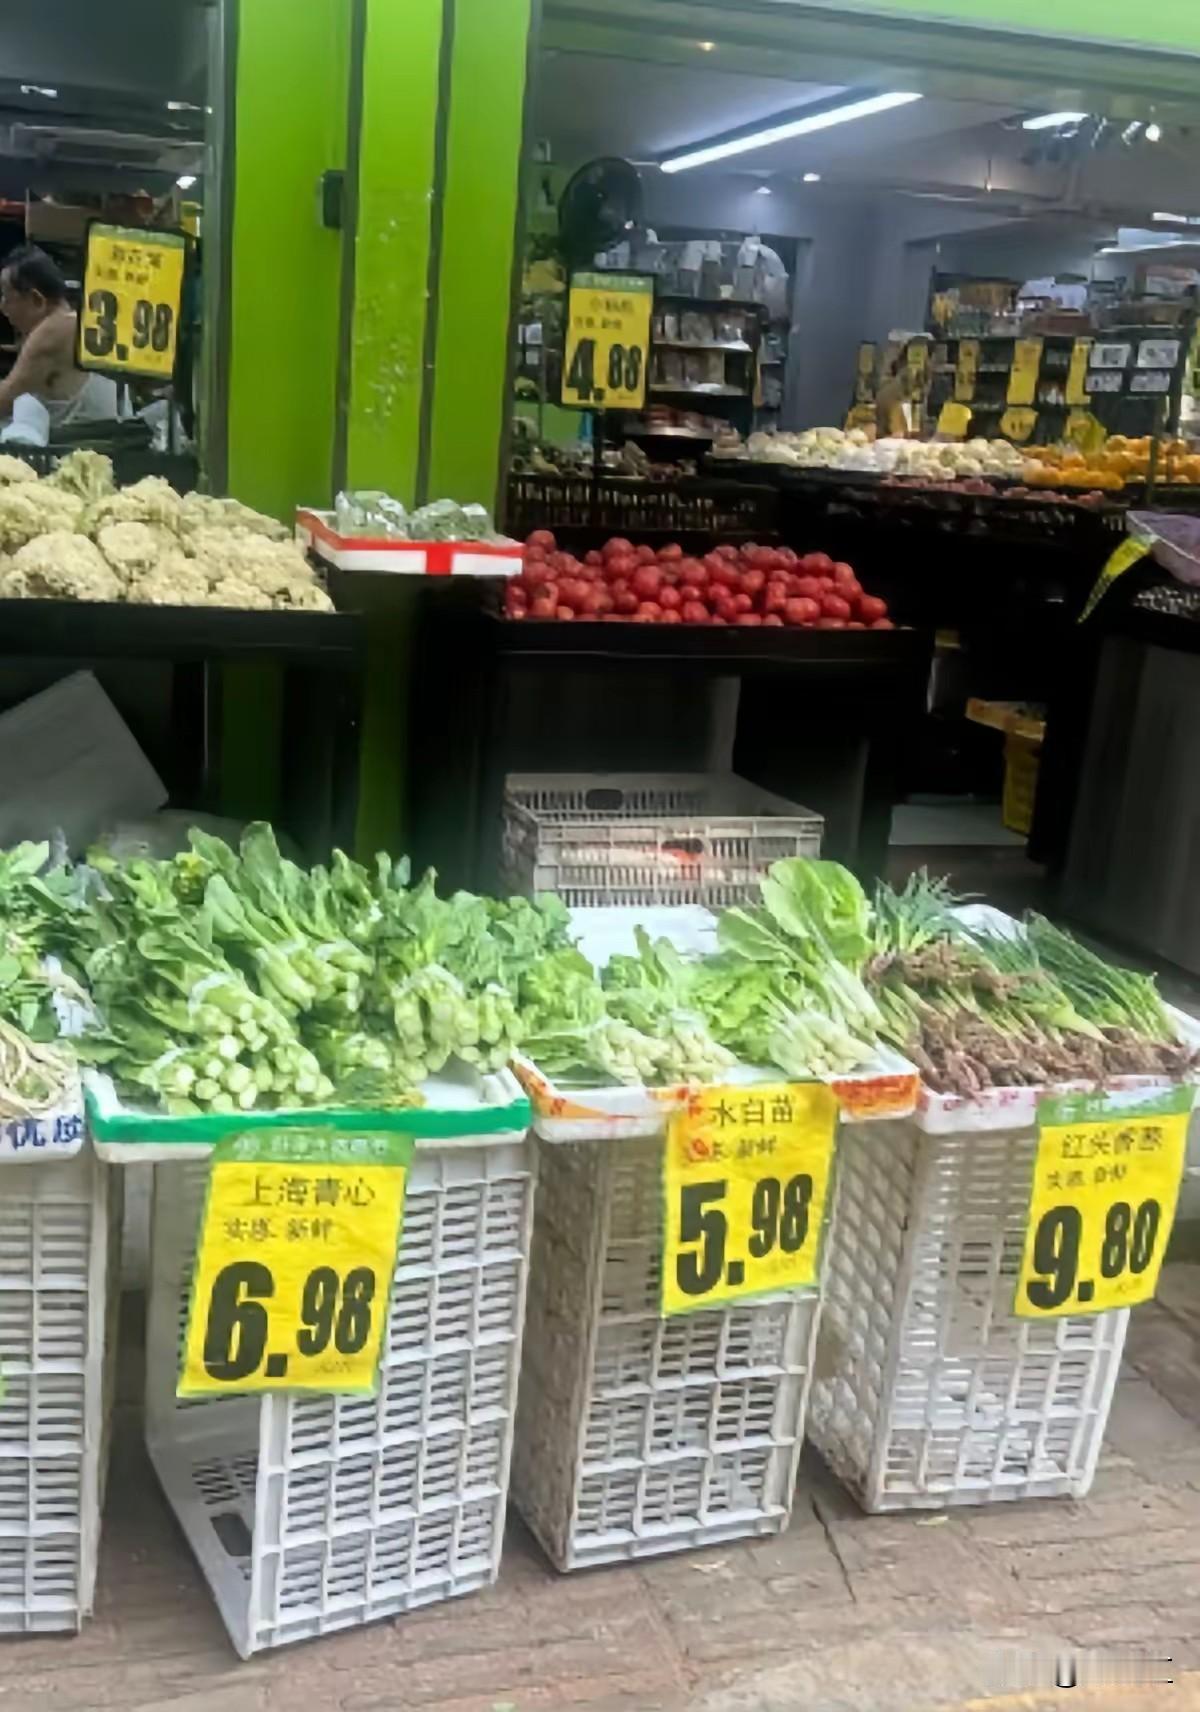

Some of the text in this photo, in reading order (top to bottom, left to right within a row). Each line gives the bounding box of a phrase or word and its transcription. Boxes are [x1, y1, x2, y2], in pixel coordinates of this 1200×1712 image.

[84, 289, 173, 361] 3.98
[565, 337, 642, 402] 4.88
[709, 1094, 794, 1129] 水白苗
[241, 1176, 377, 1208] 上海青心
[676, 1173, 813, 1296] 5.98
[1026, 1198, 1161, 1311] 9.80
[203, 1261, 376, 1382] 6.98
